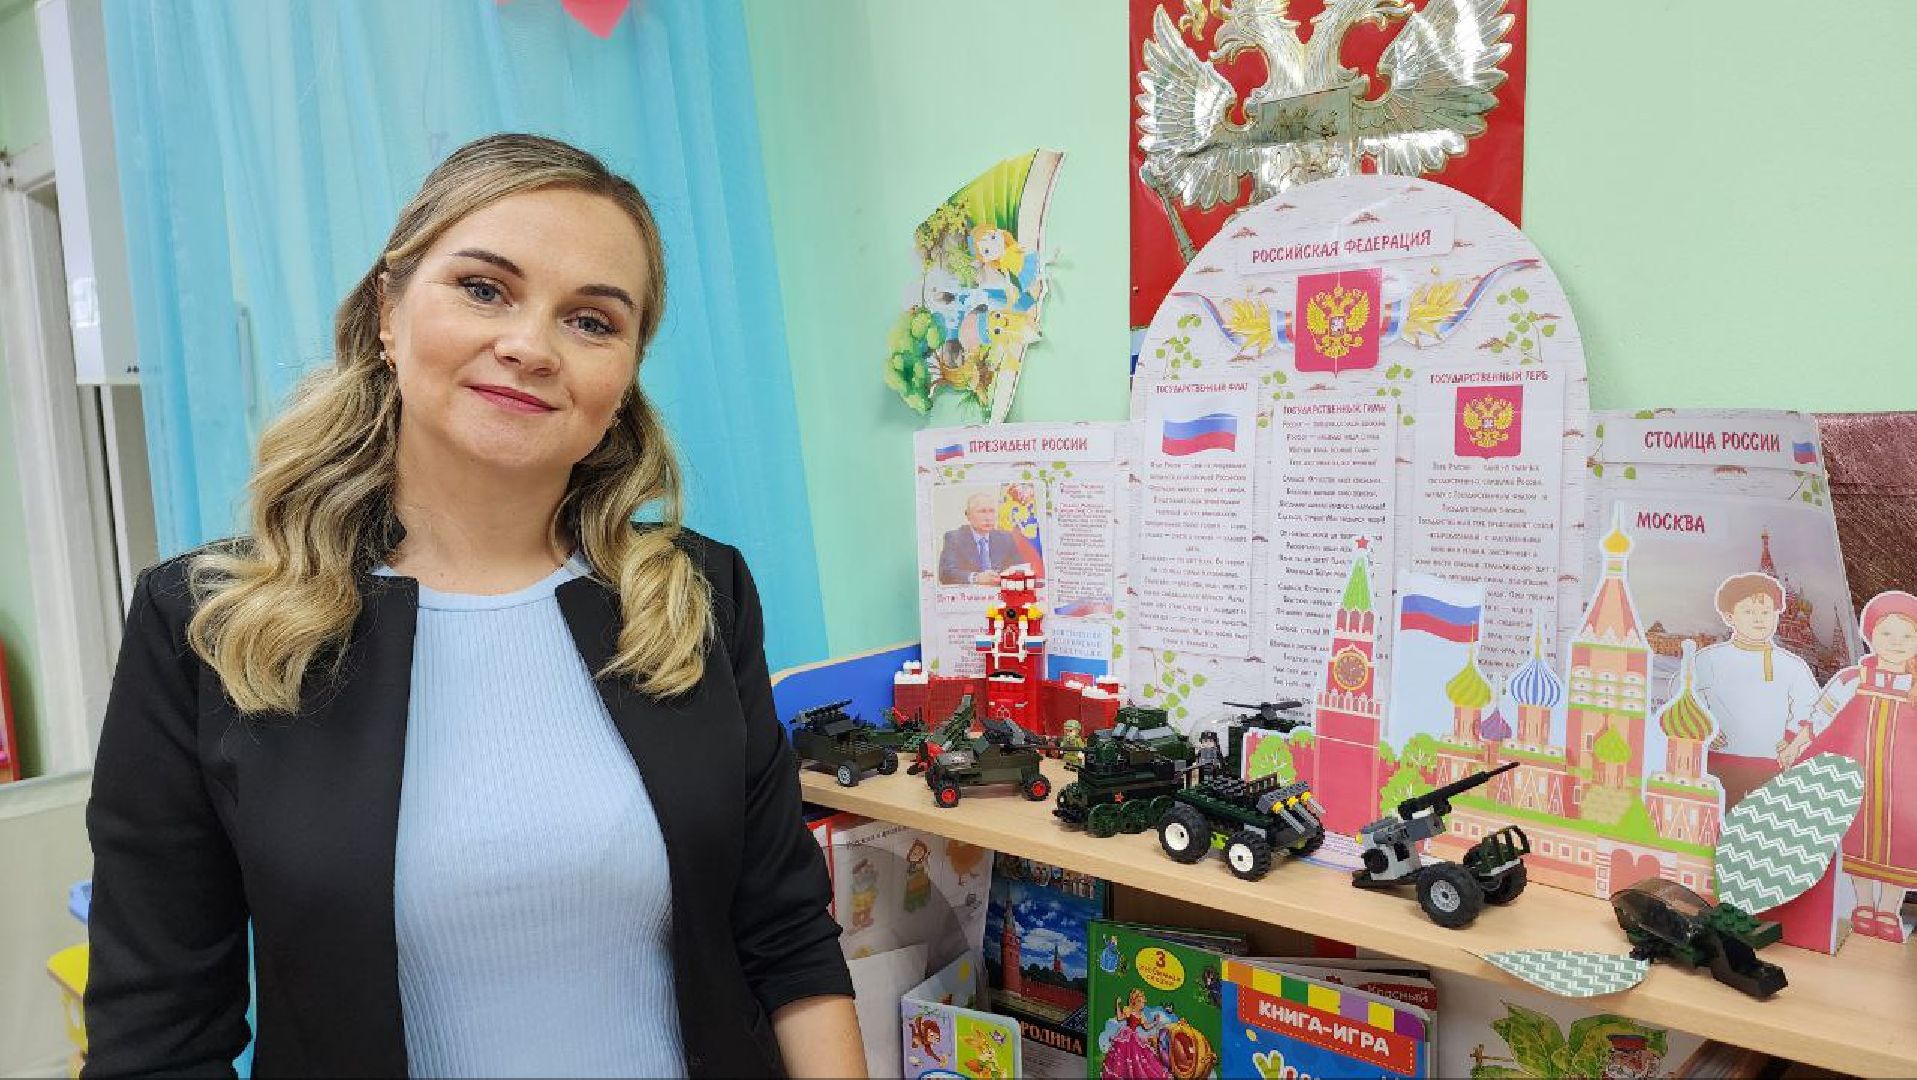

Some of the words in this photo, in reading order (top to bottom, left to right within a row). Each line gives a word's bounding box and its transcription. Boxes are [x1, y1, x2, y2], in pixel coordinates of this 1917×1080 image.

[1252, 240, 1339, 263] РОССИЙСКАЯ
[1344, 229, 1432, 252] ФЕДЕРАЦИЯ
[1429, 371, 1522, 384] ГОСУДАРСТВЕННЫЙ
[1525, 370, 1549, 381] ГЕРБ
[969, 438, 1037, 453] ПРЕЗИДЕНТ
[1041, 437, 1088, 451] РОССИИ
[1644, 431, 1716, 453] СТОЛИЦА
[1721, 431, 1780, 453] РОССИИ
[1636, 511, 1706, 534] МОСКВА
[1155, 950, 1166, 968] 3
[1020, 1019, 1083, 1055] РОДИНА
[1258, 999, 1390, 1057] КНИГА-ИГРА
